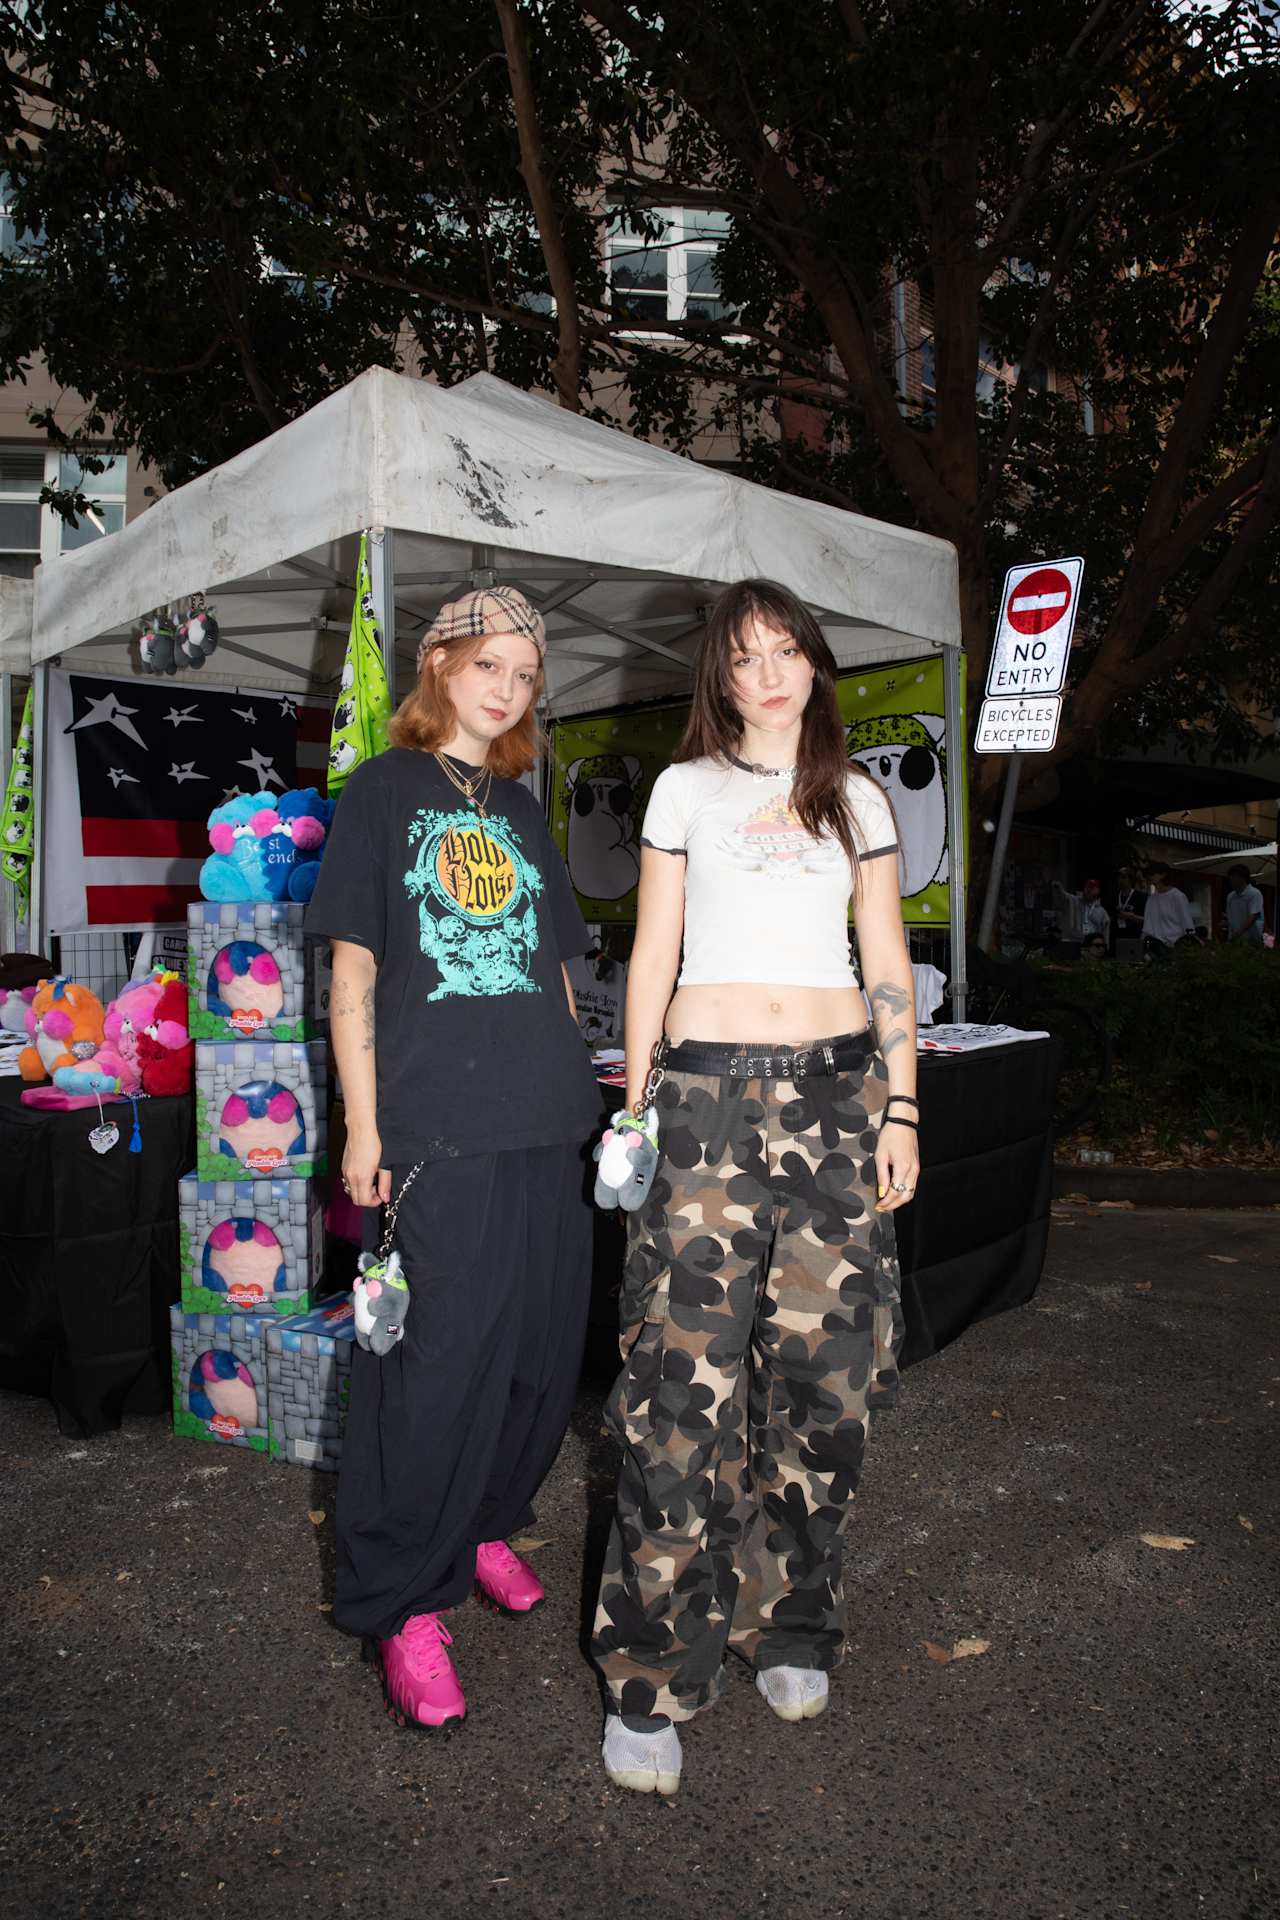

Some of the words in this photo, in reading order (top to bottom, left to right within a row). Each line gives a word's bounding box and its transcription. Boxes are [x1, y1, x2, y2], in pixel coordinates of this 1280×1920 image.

[1013, 642, 1047, 662] NO
[997, 666, 1055, 686] ENTRY
[988, 709, 1053, 722] BICYCLES
[983, 729, 1050, 742] EXCEPTED
